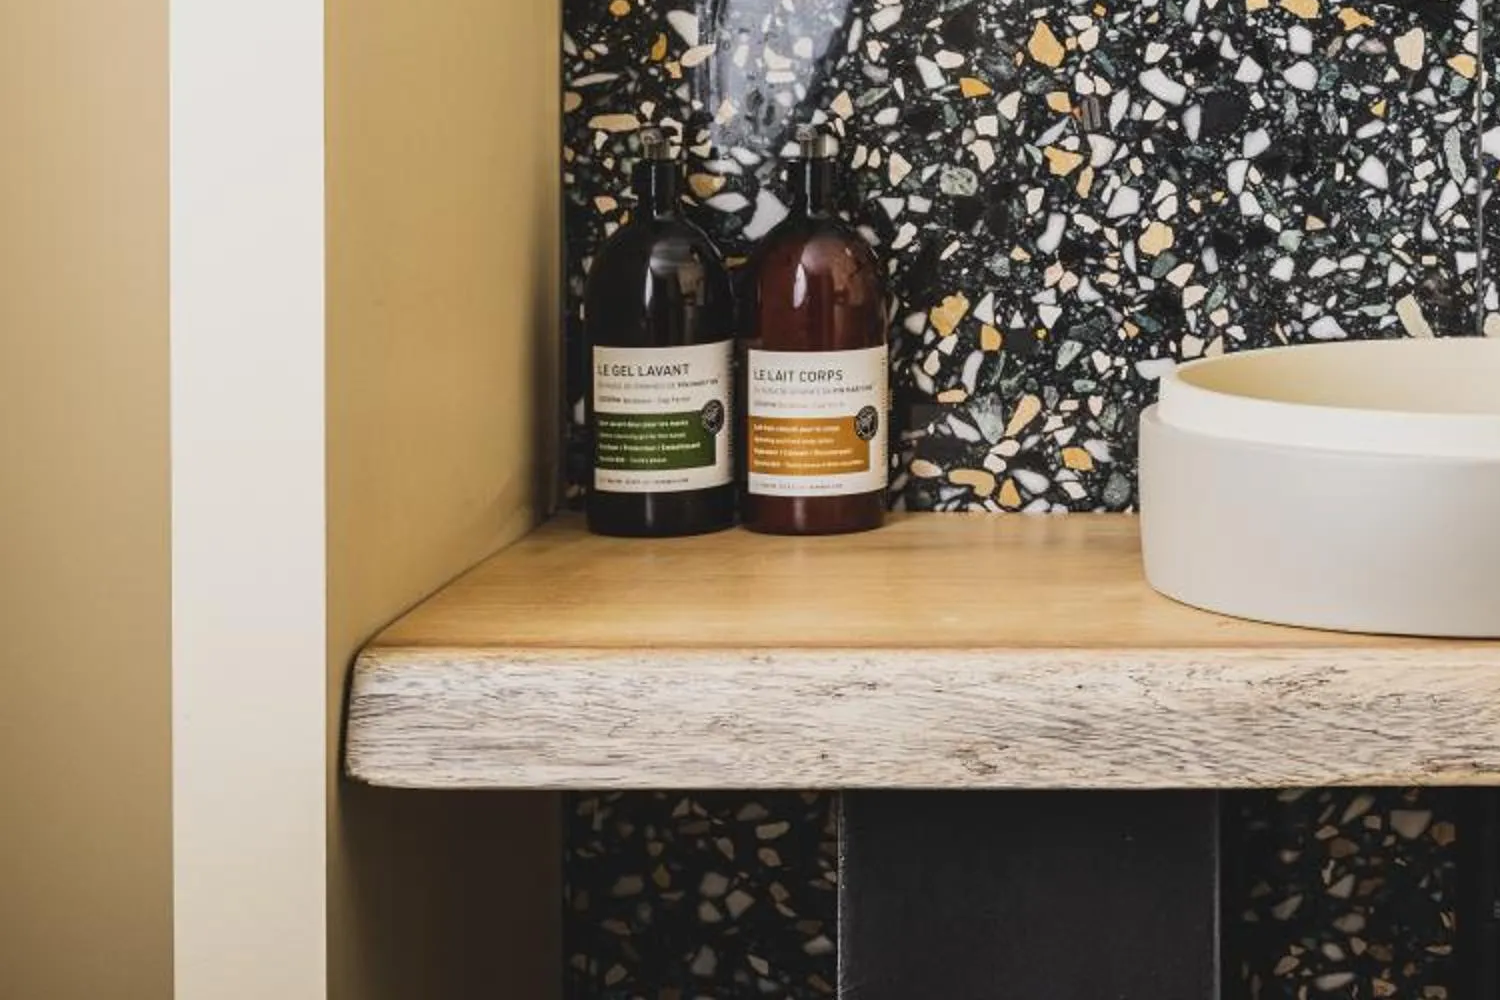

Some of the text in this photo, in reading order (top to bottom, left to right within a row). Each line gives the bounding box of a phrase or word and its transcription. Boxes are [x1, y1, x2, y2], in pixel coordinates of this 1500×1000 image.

[597, 363, 689, 377] LE GEL LAVANT
[753, 369, 843, 383] LE LAIT CORPS
